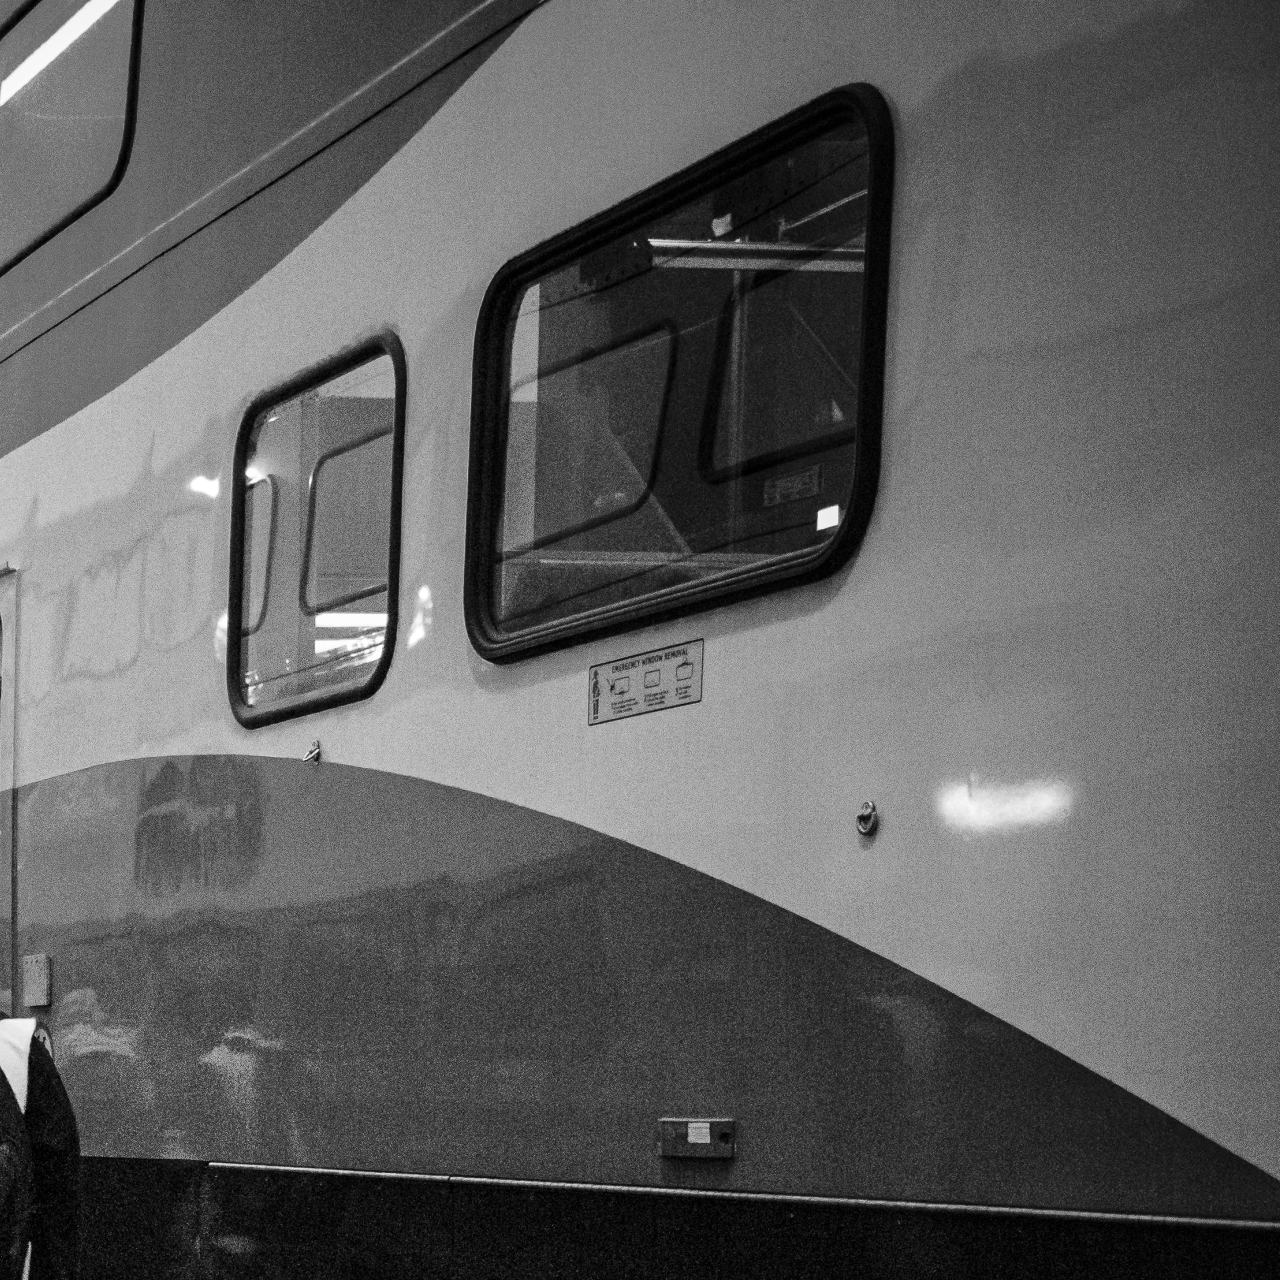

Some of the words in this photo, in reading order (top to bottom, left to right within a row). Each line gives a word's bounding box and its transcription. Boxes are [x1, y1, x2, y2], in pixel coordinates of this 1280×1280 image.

[612, 660, 640, 674] EMERGENCY
[641, 654, 663, 666] WINDOW
[664, 648, 688, 660] REMOVAL
